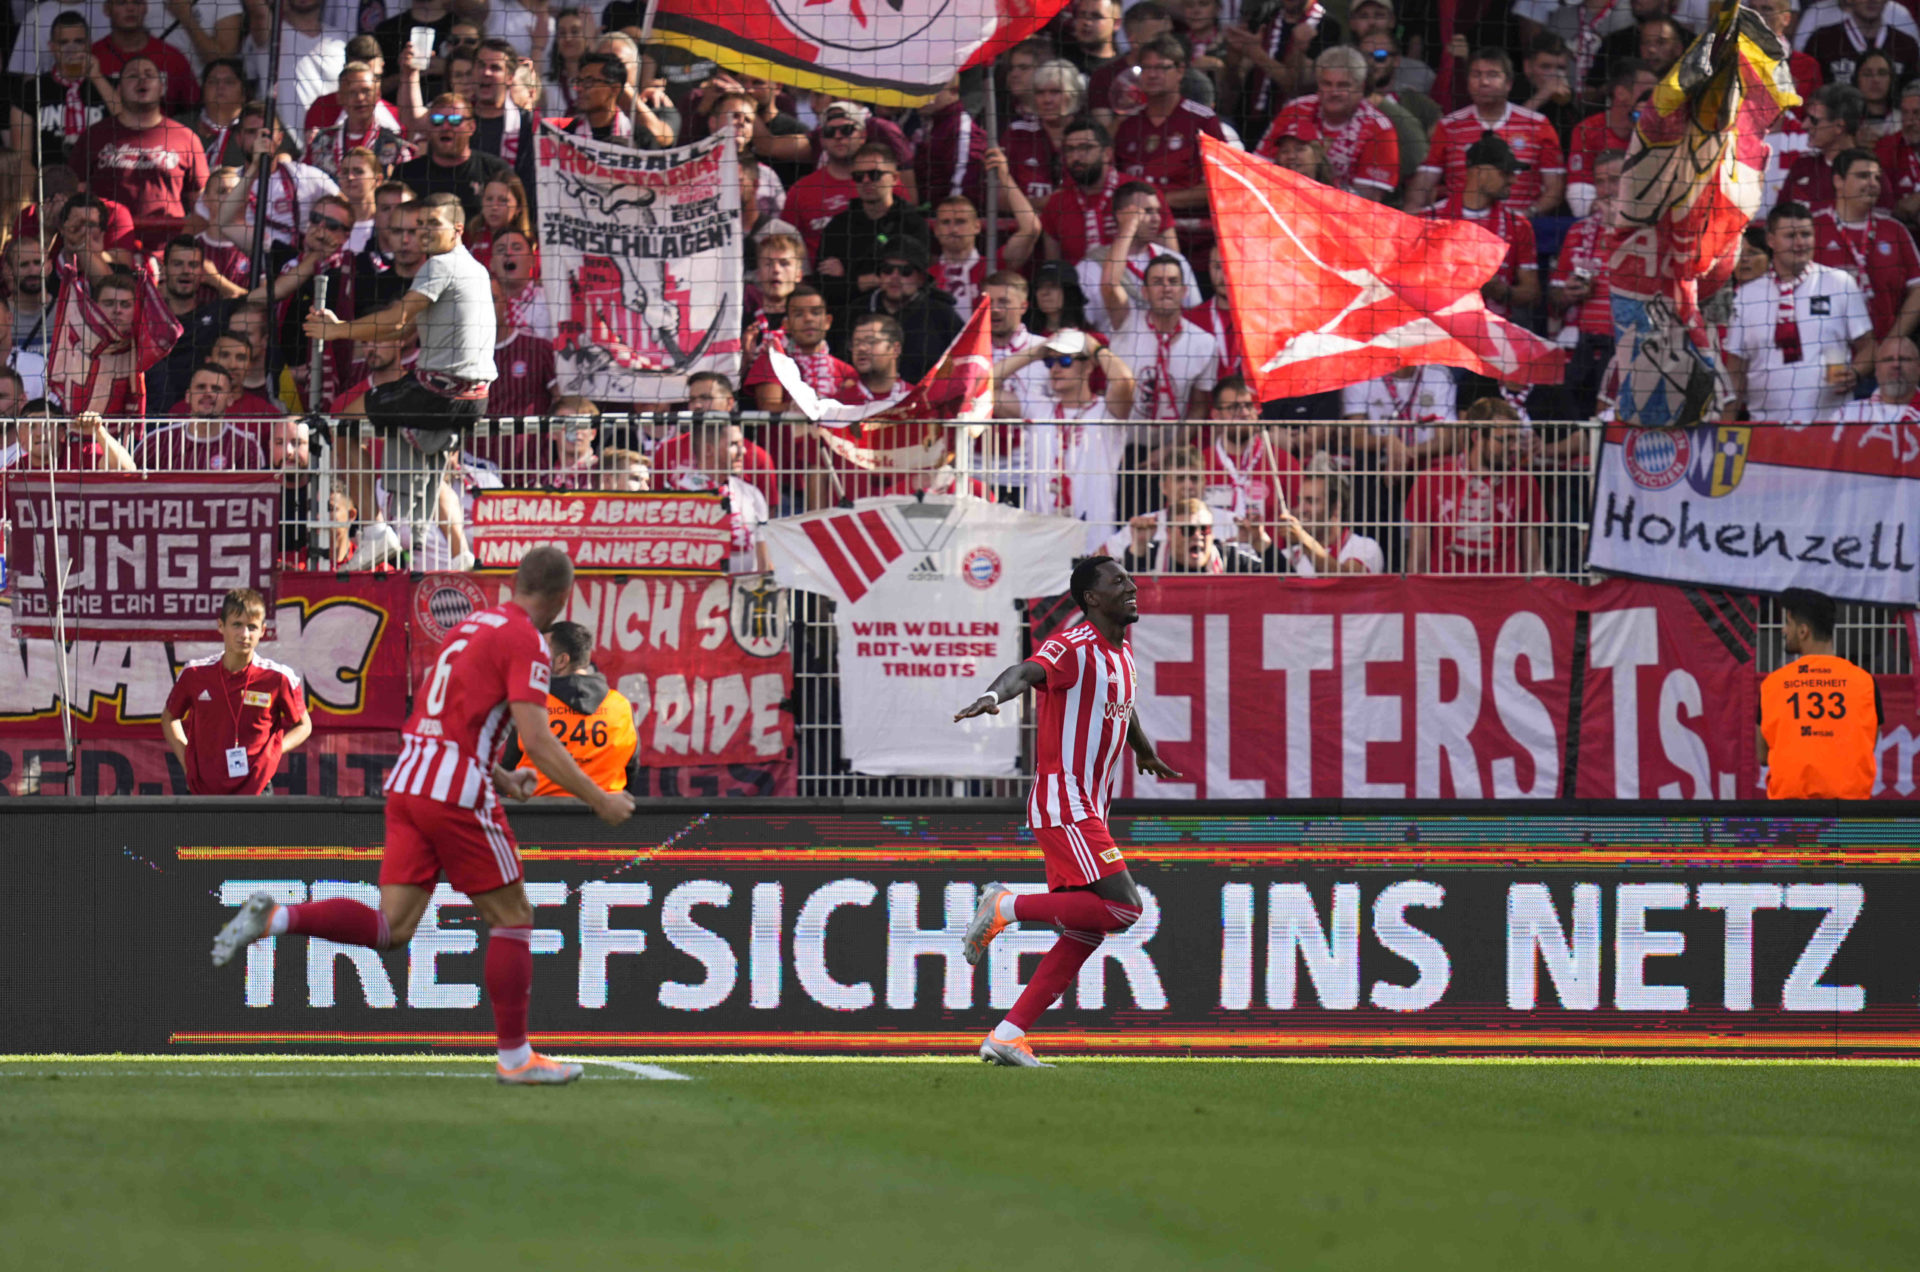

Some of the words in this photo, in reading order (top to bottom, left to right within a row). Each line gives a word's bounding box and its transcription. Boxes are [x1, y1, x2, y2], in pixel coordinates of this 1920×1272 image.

[543, 222, 733, 258] ZERSCHLAGEN!
[15, 498, 274, 530] DURCHHALTEN
[477, 498, 585, 524] NIEMALS
[591, 499, 727, 525] ABWESEND
[1604, 491, 1915, 572] Hohenzell
[17, 533, 272, 590] JUNGS!
[575, 541, 725, 566] ANWESEND
[110, 595, 155, 613] CAN
[162, 594, 223, 614] STOP
[499, 579, 732, 651] NICH'S
[852, 622, 898, 637] WIR
[904, 622, 999, 637] WOLLEN
[857, 642, 998, 657] ROT-WEISSE
[427, 639, 468, 716] 6
[882, 662, 977, 677] TRIKOTS
[1783, 679, 1847, 689] SICHERHEIT
[616, 673, 786, 756] PRIDE
[1108, 610, 1559, 799] ELTERS
[1786, 692, 1846, 719] 133
[550, 719, 608, 748] 246
[1221, 880, 1451, 1012] INS
[1507, 881, 1865, 1012] NETZ
